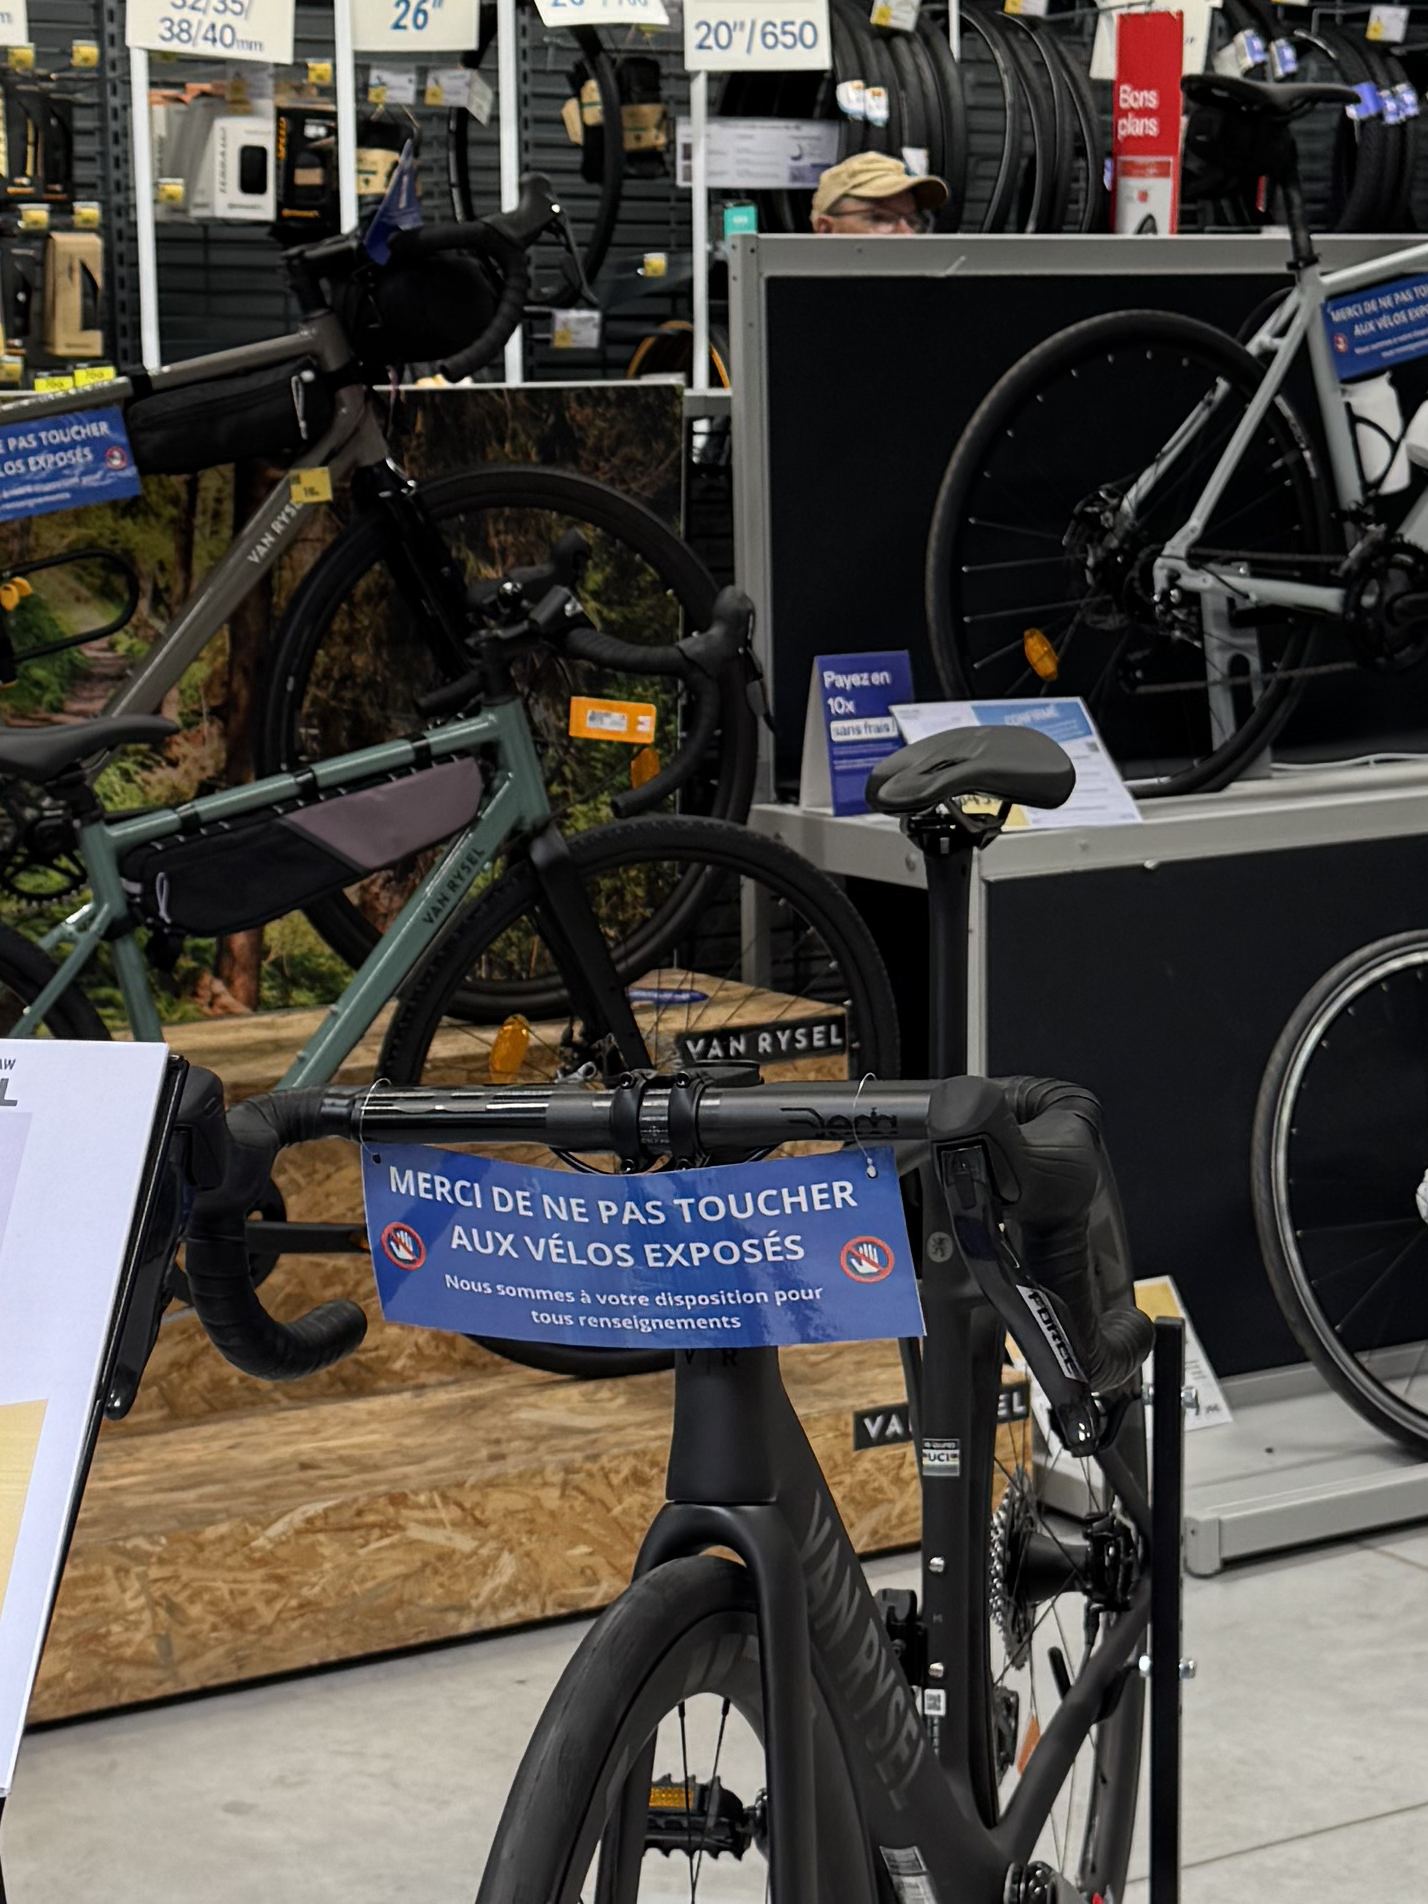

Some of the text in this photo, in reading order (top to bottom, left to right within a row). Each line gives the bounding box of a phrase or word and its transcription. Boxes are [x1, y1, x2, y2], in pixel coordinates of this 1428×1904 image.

[1119, 84, 1158, 109] Bons
[1117, 112, 1158, 140] plans
[1330, 304, 1364, 323] MERCI
[1364, 300, 1378, 315] DE
[1378, 295, 1393, 309] NE
[1394, 289, 1414, 306] PAS
[8, 434, 37, 452] PAS
[38, 421, 111, 446] TOUCHER
[28, 444, 94, 472] EXPOSÉS
[247, 531, 276, 564] VAN
[823, 670, 891, 691] Payez en
[826, 697, 856, 715] 10x
[832, 724, 862, 737] sans
[863, 719, 890, 735] frais
[422, 847, 486, 924] VAN RYSEL
[686, 1024, 843, 1059] VAN RYSEL
[389, 1164, 857, 1225] MERCI DE NE PAS TOUCHER
[450, 1224, 805, 1268] AUX VÉLOS EXPOSÉS
[445, 1273, 823, 1312] Nous sommes à votre disposition pour
[531, 1308, 742, 1335] tous renseignements
